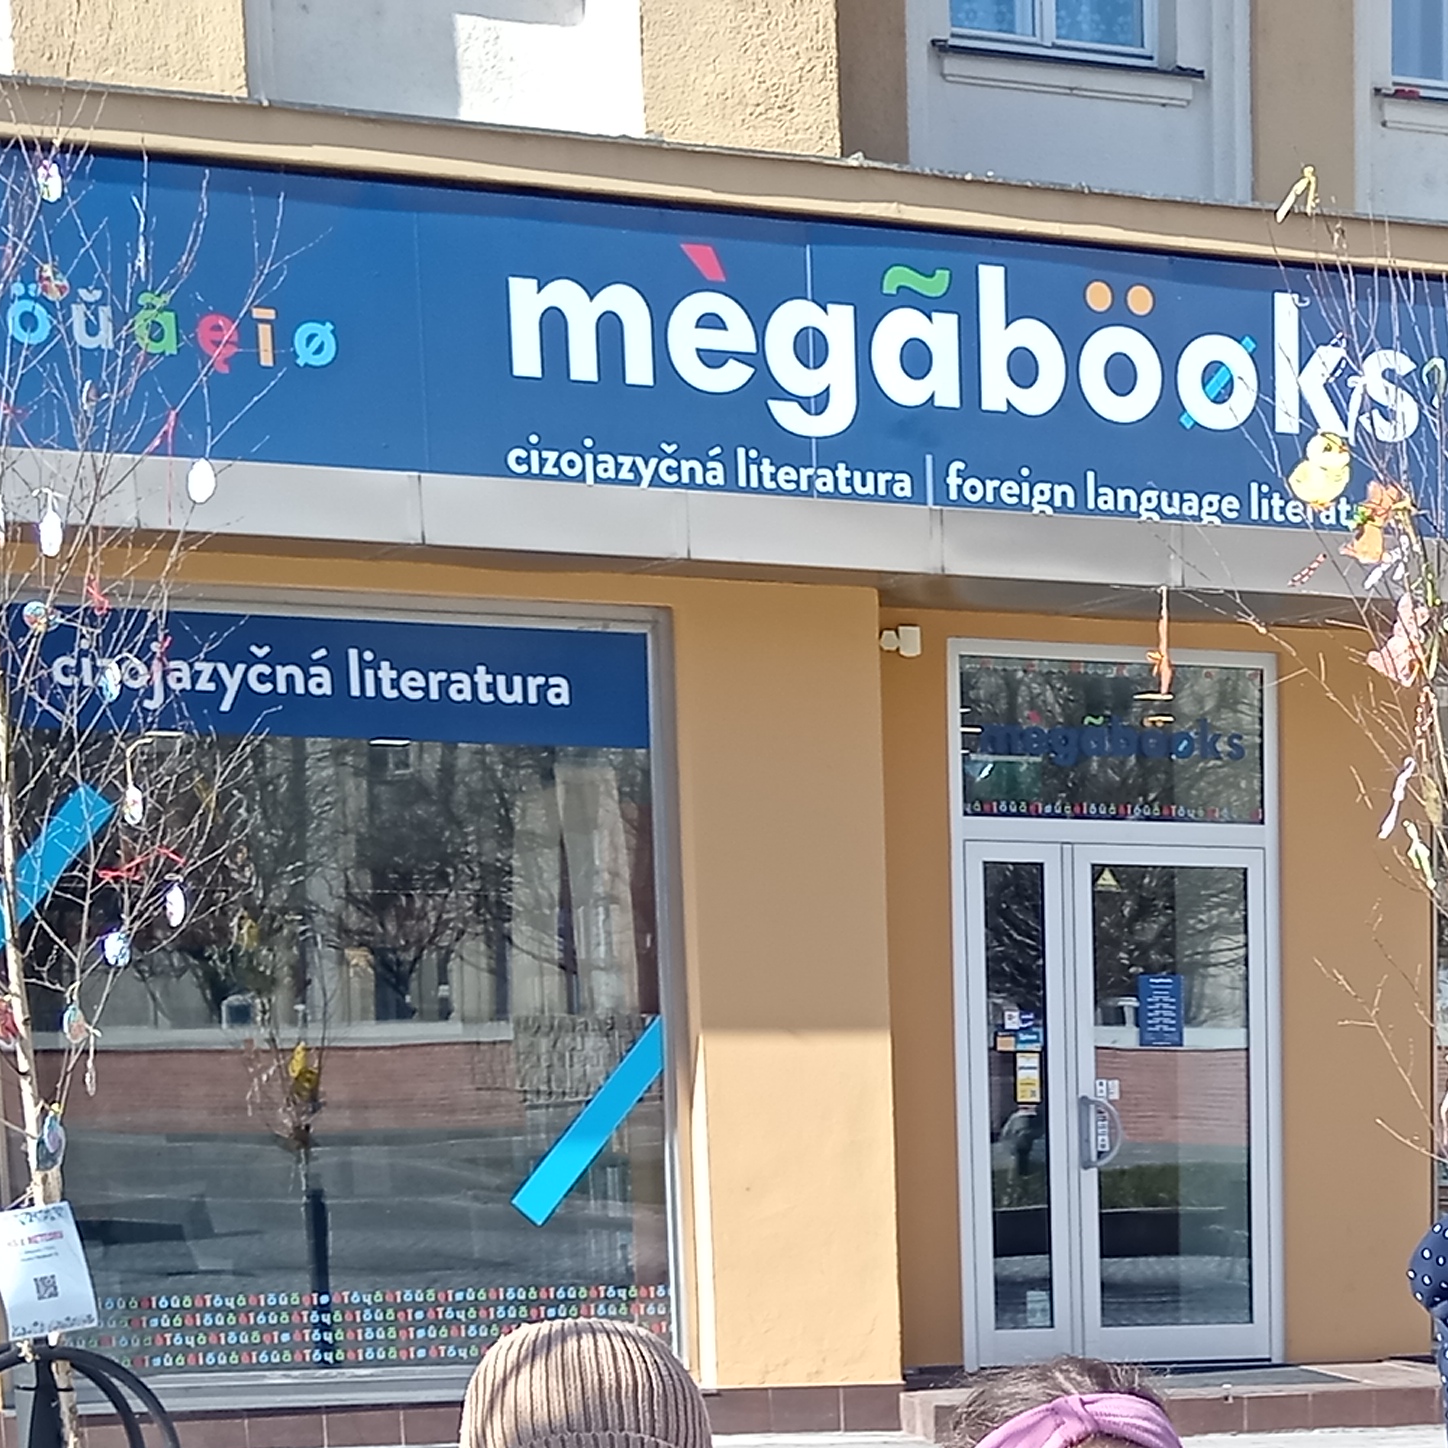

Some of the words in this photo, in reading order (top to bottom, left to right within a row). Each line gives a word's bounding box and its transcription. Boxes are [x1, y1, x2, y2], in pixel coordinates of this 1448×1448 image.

[505, 433, 725, 486] cizojazyčná
[735, 448, 913, 499] literatura
[946, 460, 1077, 517] foreign
[1084, 468, 1241, 527] language
[349, 648, 571, 707] literatura
